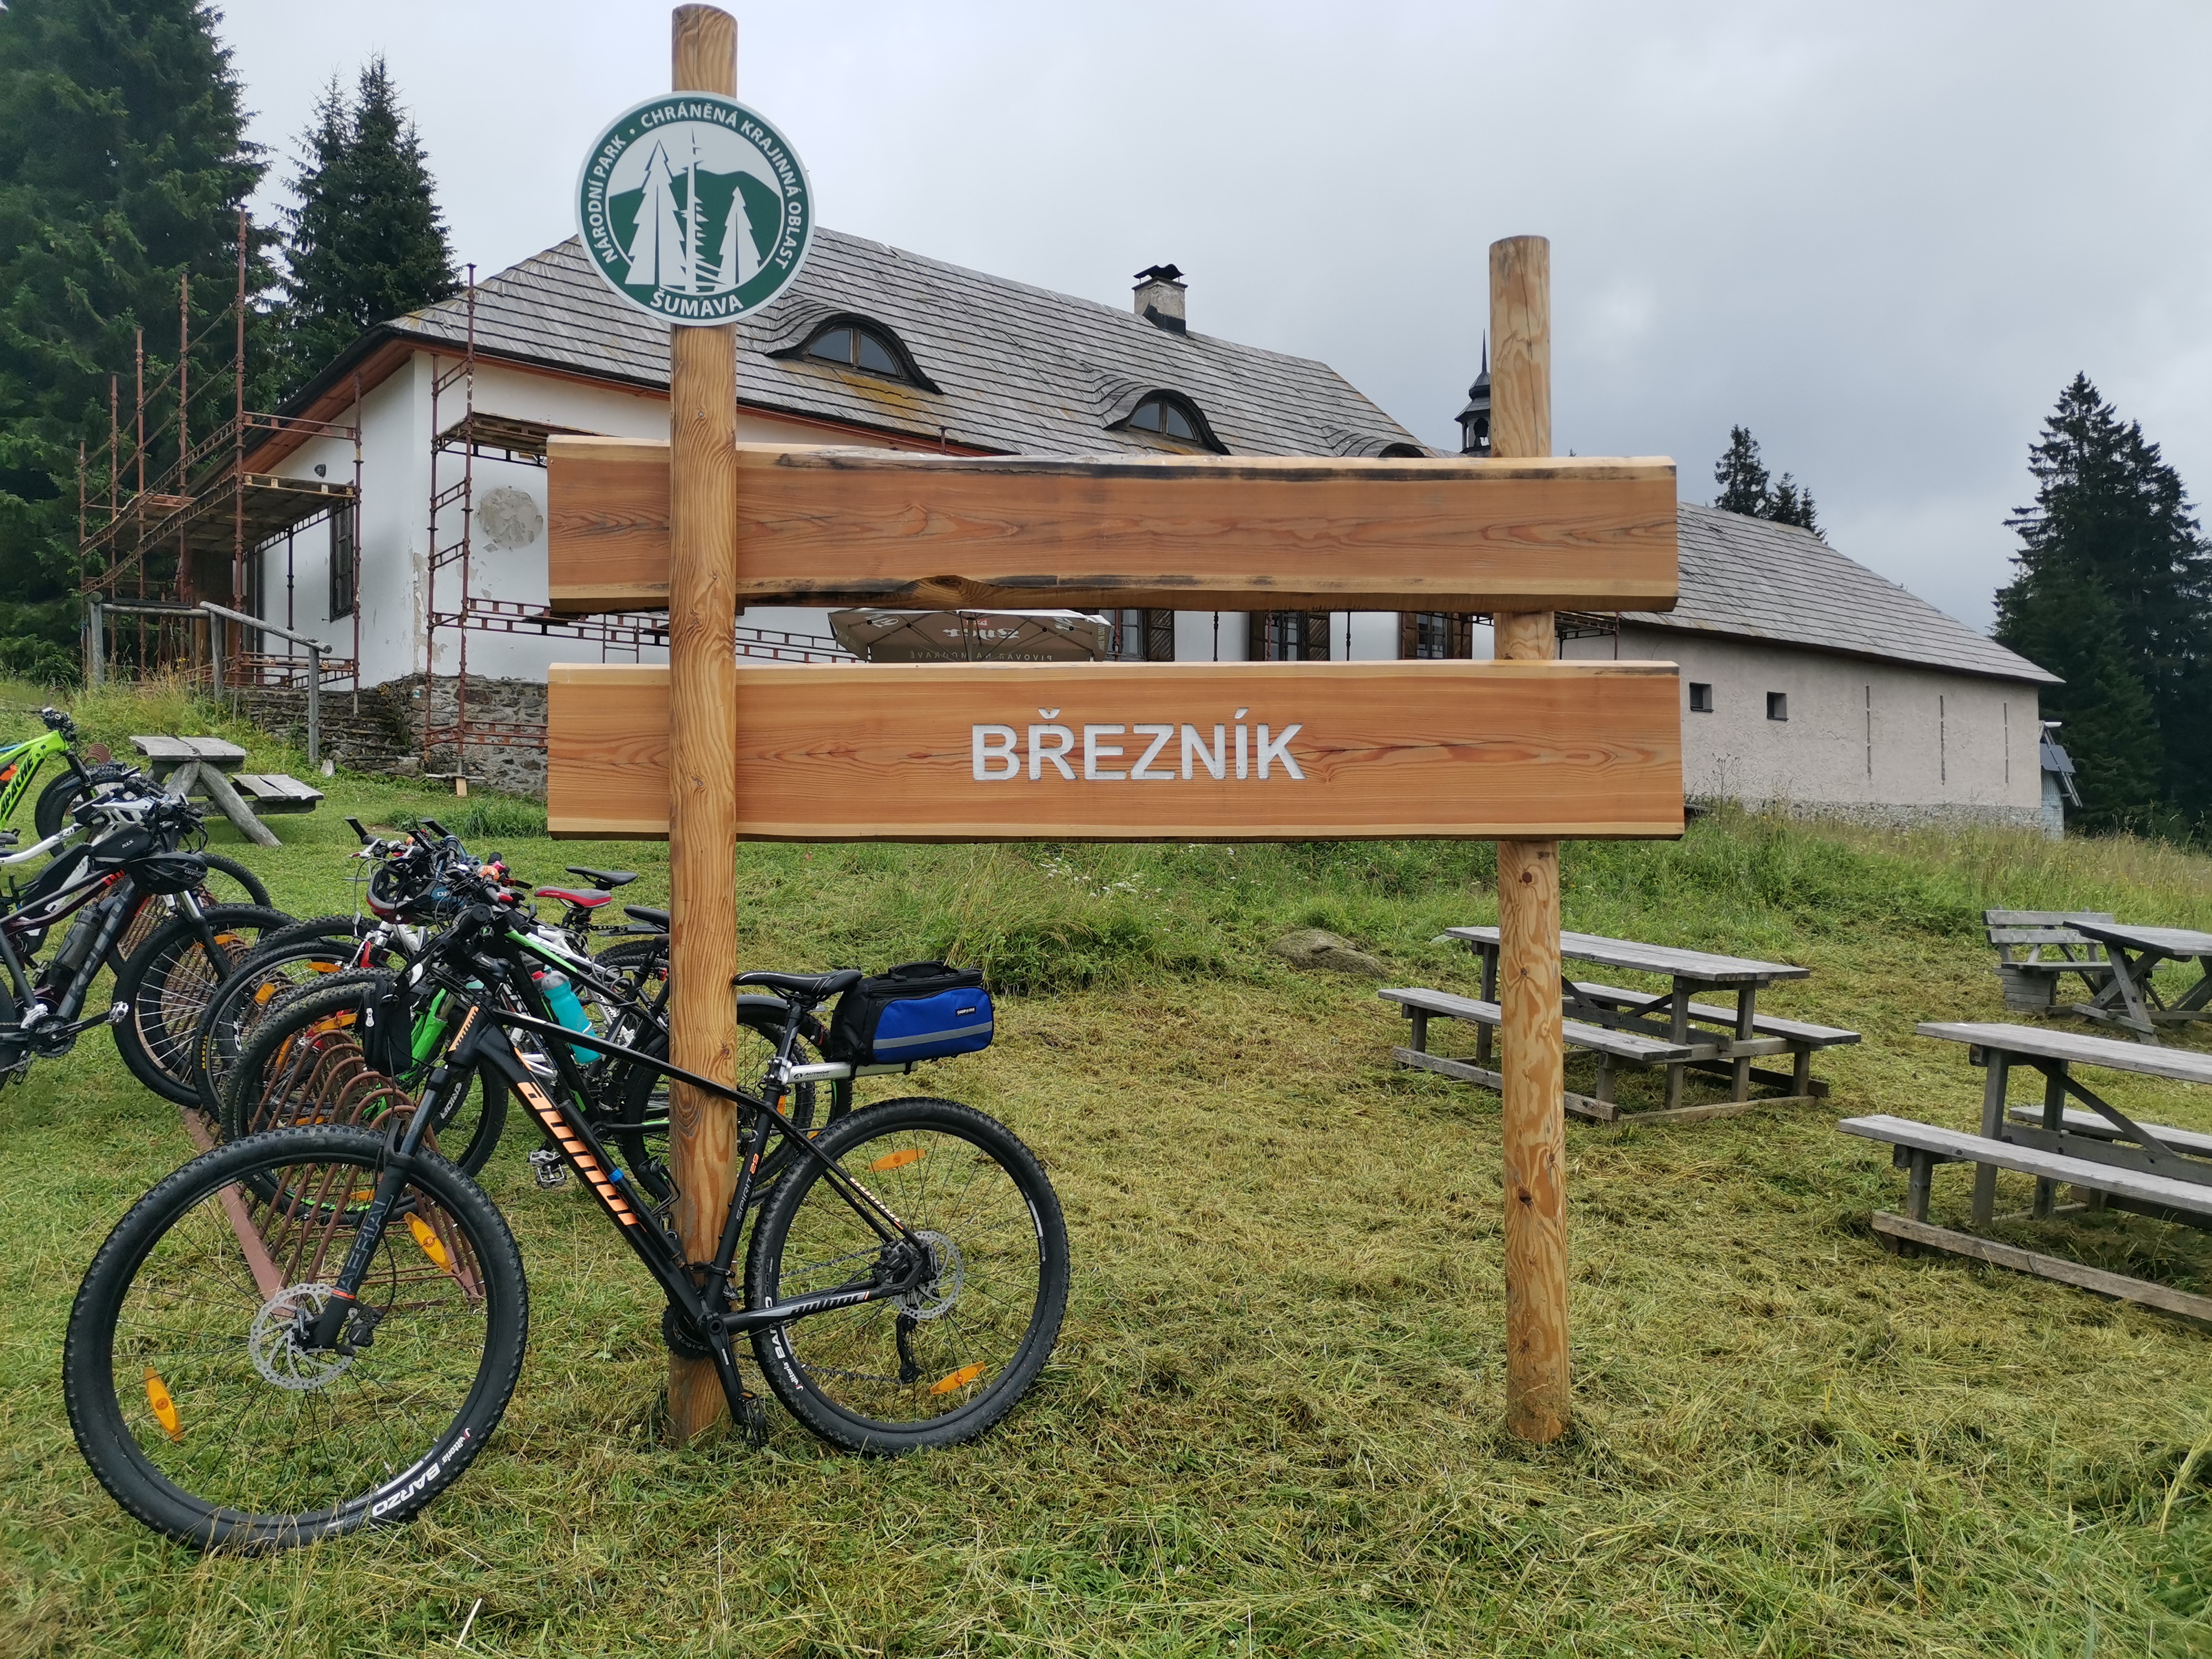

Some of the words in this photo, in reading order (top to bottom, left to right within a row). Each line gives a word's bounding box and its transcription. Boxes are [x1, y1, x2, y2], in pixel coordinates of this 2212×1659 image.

[594, 134, 627, 178] PARK
[640, 101, 737, 129] CHRÁNĚNÁ
[740, 119, 802, 198] KRAJINNÁ
[774, 201, 802, 270] OBLAST
[587, 178, 618, 263] NÁRODNÍ
[650, 285, 744, 317] ŠUMAVA
[972, 707, 1306, 780] BŘEZNÍK
[0, 753, 34, 818] APACHE
[736, 1173, 752, 1222] SPIRIT
[749, 1153, 759, 1174] 29
[442, 1436, 466, 1464] vittoria
[372, 1462, 441, 1517] BARZO
